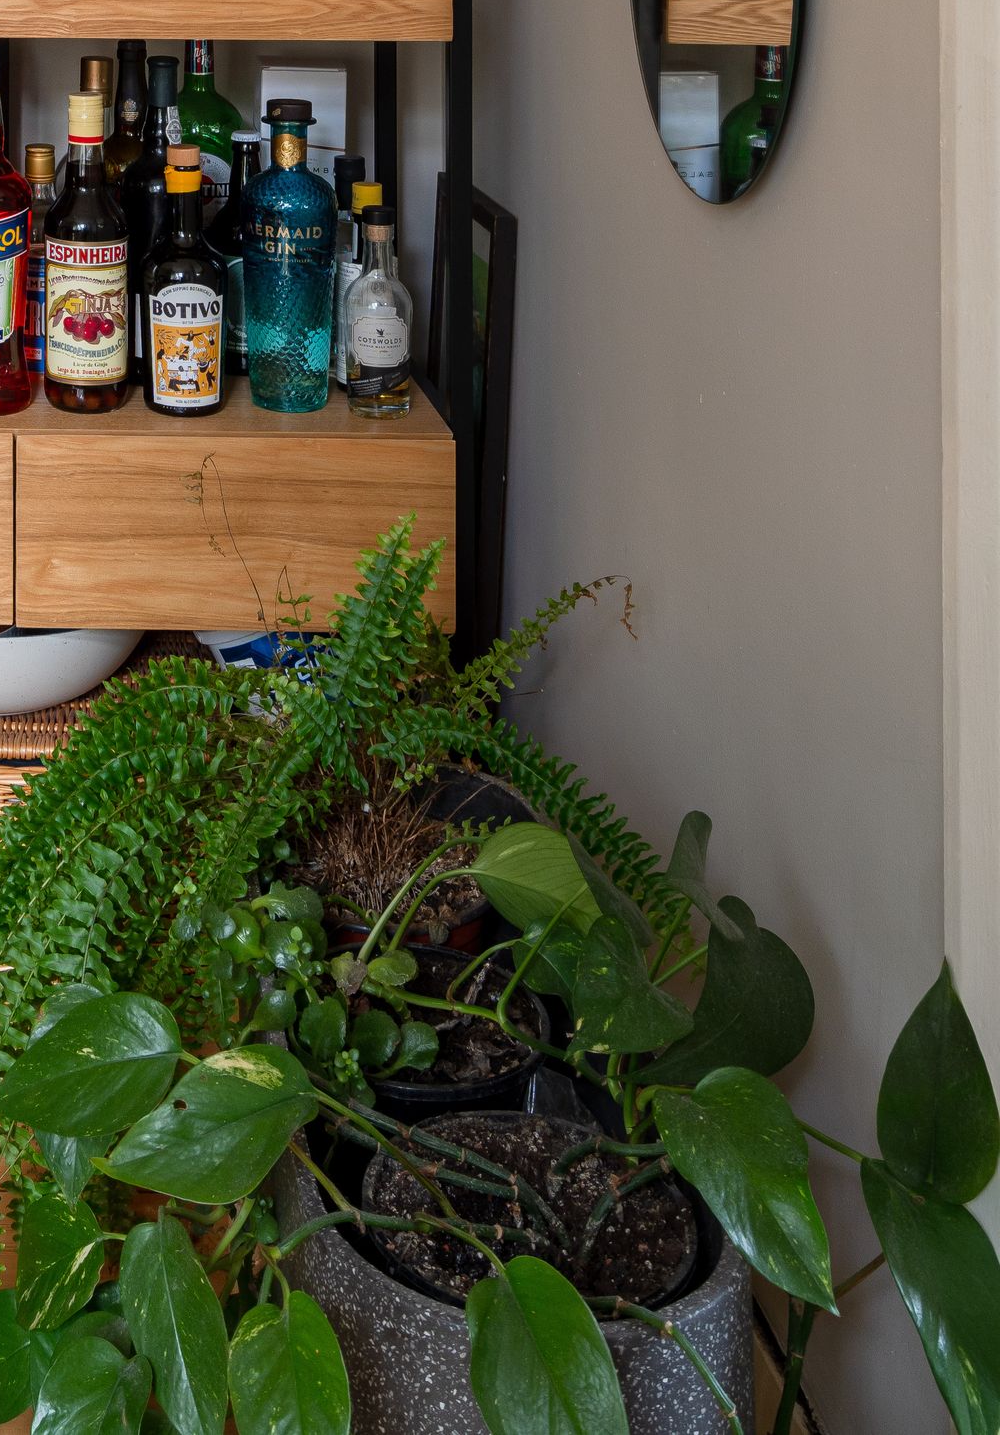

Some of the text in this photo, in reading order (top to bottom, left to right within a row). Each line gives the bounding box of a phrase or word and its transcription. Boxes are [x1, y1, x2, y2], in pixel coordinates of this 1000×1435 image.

[202, 184, 229, 197] TINI
[48, 243, 127, 264] ESPINHEIRA
[264, 241, 296, 255] GIN
[65, 297, 112, 315] GINJA
[152, 299, 220, 319] BOTIVO
[357, 336, 402, 345] COTSWOLDS
